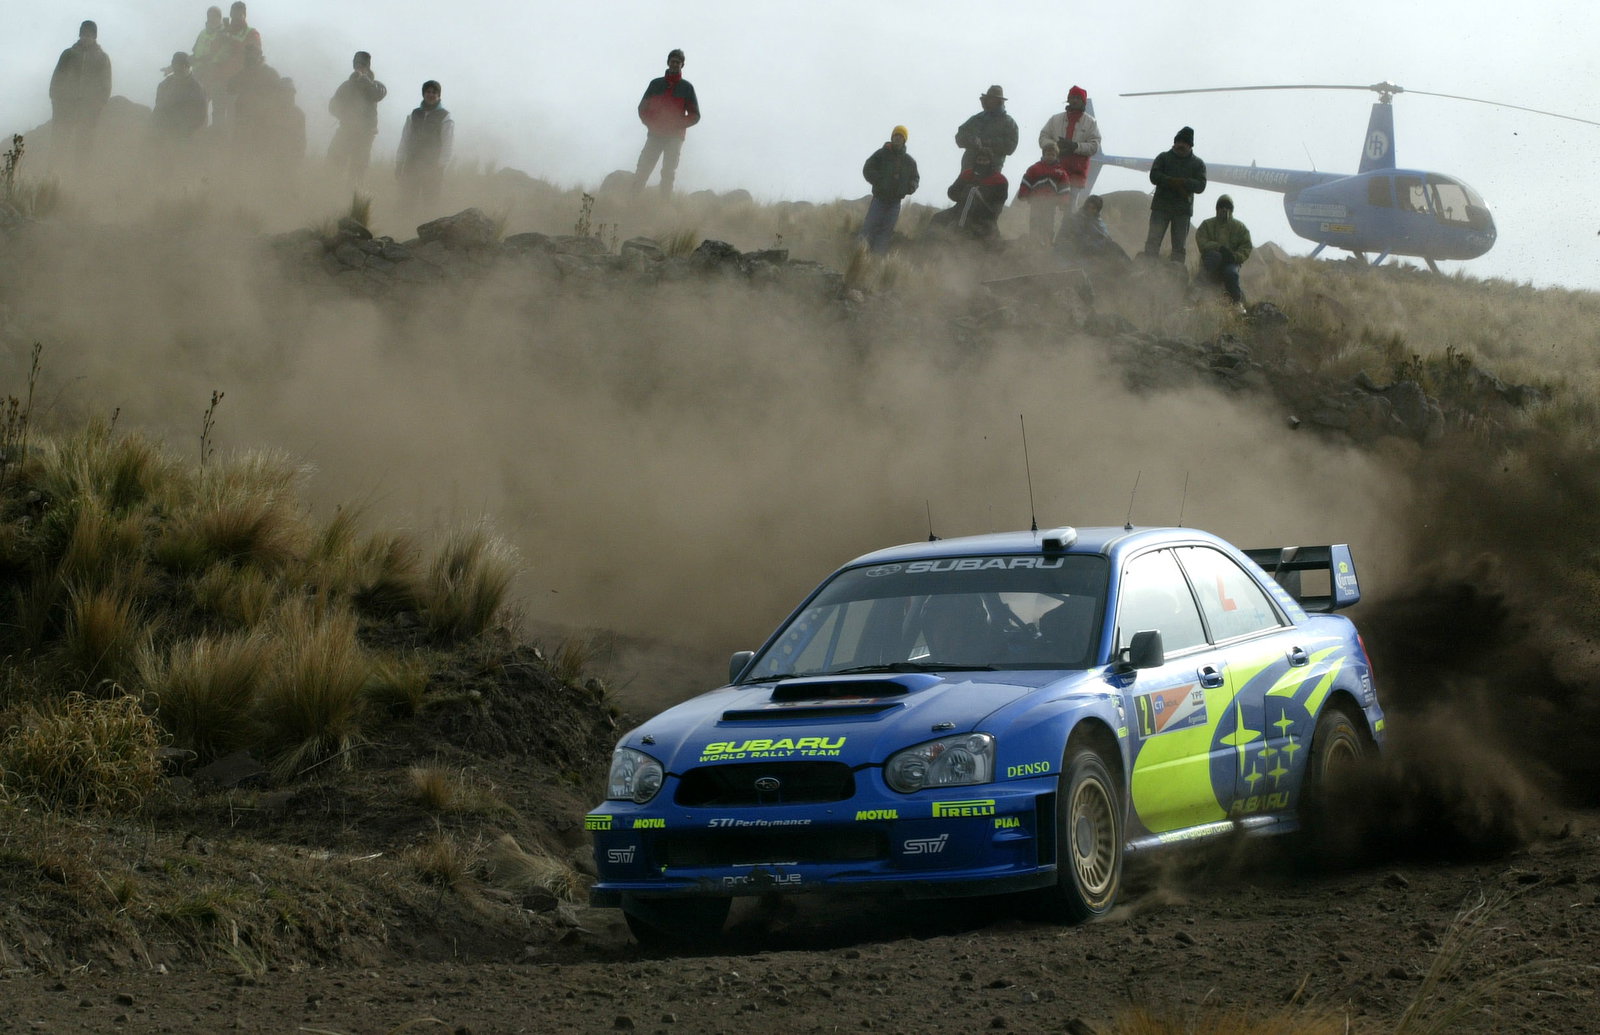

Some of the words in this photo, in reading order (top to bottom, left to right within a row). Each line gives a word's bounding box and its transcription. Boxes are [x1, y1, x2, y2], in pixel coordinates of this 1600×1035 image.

[905, 557, 1065, 574] SUBARU
[703, 737, 846, 754] SUBARU
[699, 752, 746, 762] WORLD
[750, 750, 794, 758] RALLY
[1007, 761, 1050, 777] DENSO
[932, 800, 995, 817] PIRELLI
[855, 810, 898, 820] MOTUL
[633, 819, 666, 828] MOTUL
[707, 818, 734, 828] STI
[995, 817, 1020, 828] PIAA
